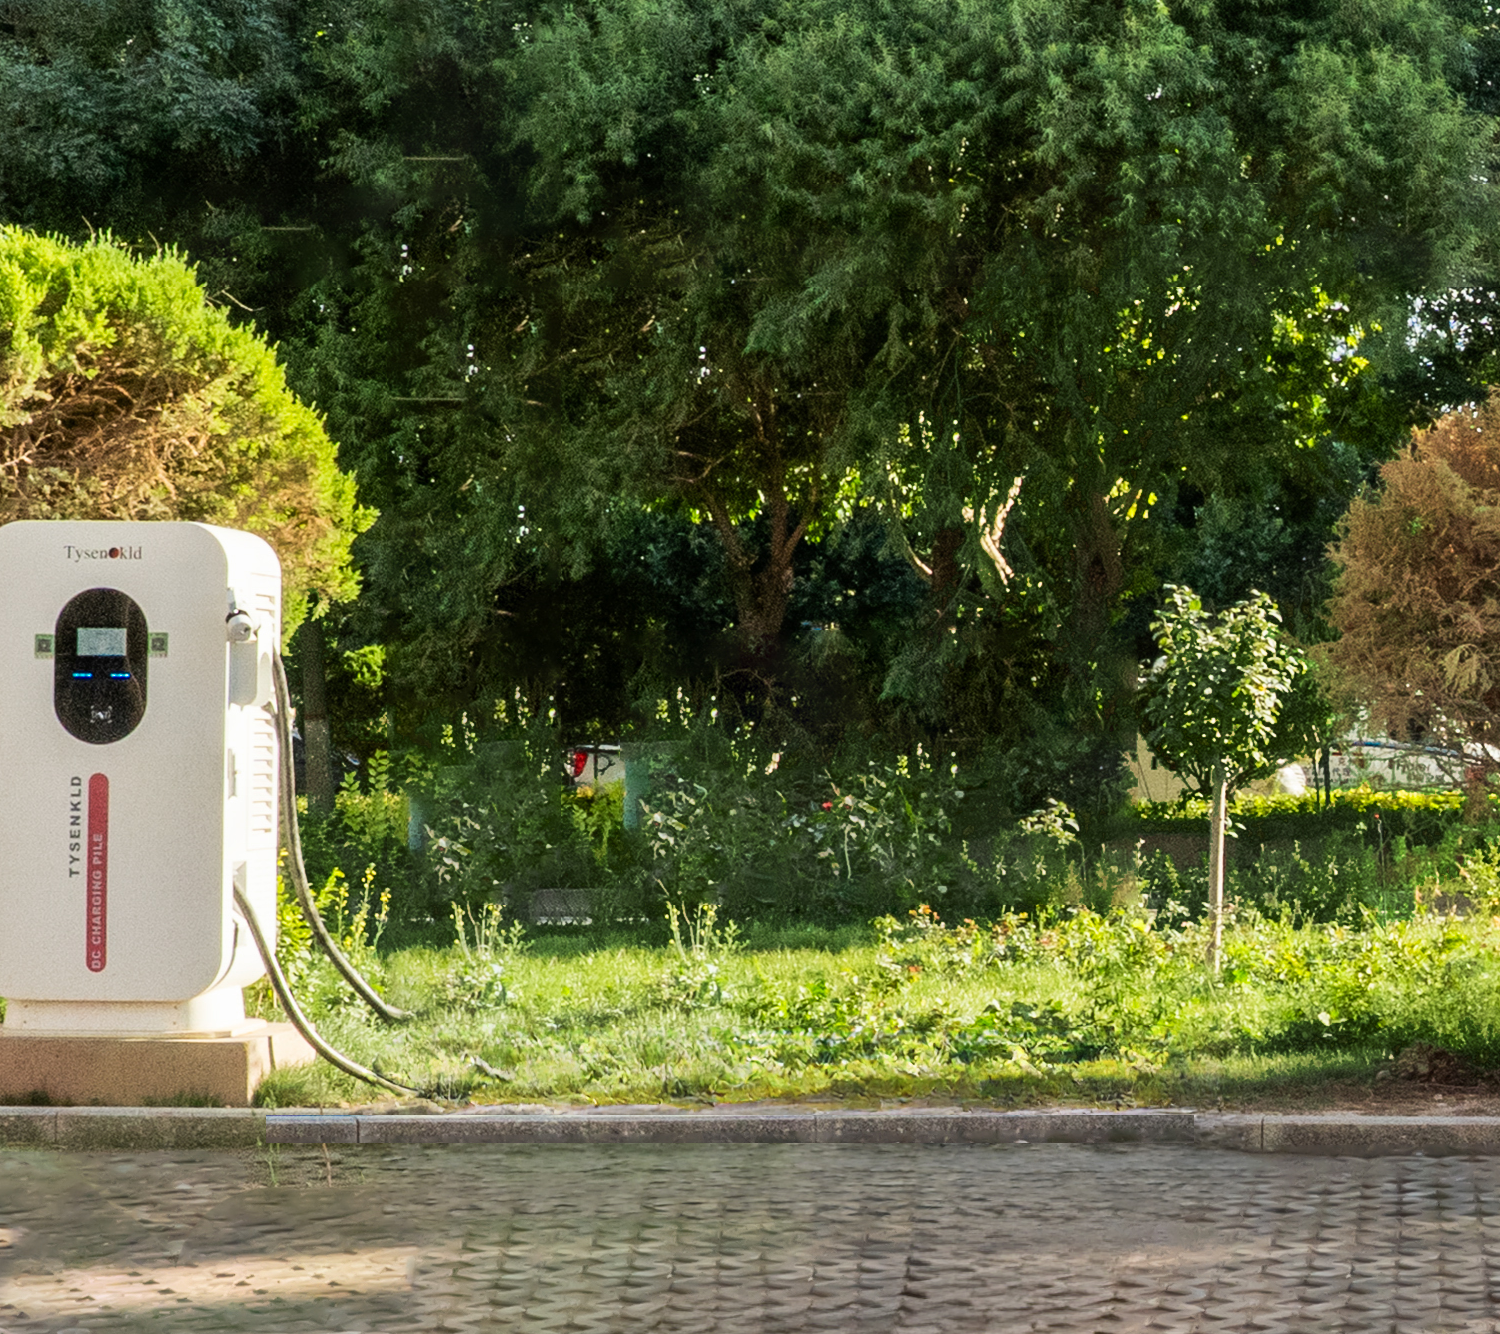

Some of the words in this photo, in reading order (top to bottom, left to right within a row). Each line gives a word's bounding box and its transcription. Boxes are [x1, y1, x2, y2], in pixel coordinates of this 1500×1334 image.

[68, 776, 82, 878] TYSENKLD
[91, 833, 103, 865] PILE
[91, 870, 103, 945] CHARGING
[91, 950, 102, 969] DC
